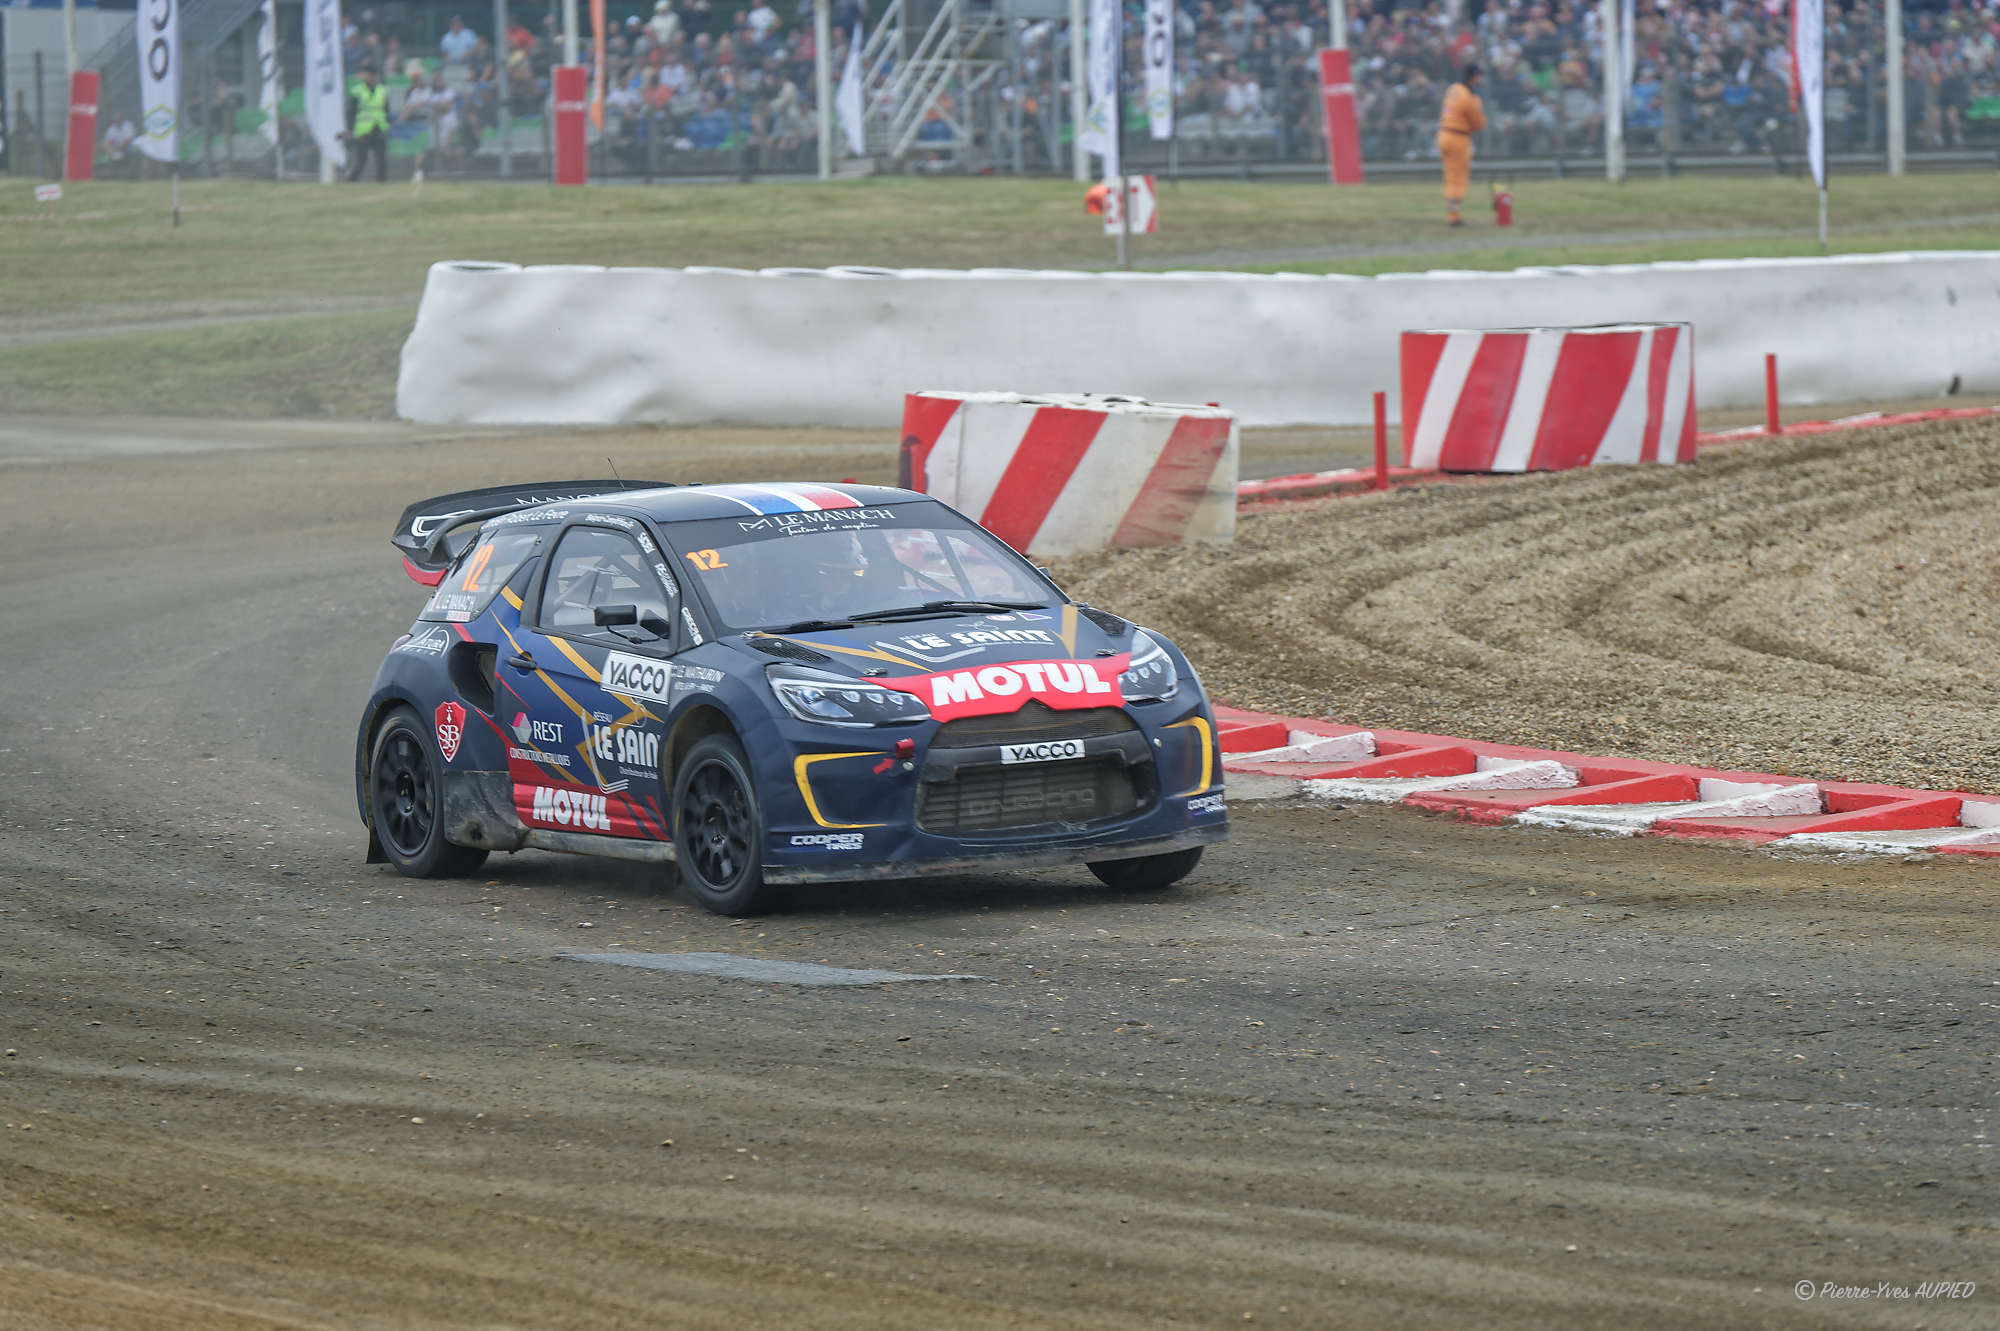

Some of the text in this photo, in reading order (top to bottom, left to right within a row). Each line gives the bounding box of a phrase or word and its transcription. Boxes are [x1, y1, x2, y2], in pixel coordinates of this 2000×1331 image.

[774, 514, 804, 527] LE
[462, 544, 495, 592] 12
[685, 548, 729, 571] 12
[905, 636, 952, 651] LE
[951, 629, 1053, 645] SAINT
[609, 660, 666, 695] YACCO
[930, 662, 1113, 707] MOTUL
[533, 720, 564, 744] REST
[594, 724, 662, 769] LE SAIN
[1009, 742, 1078, 762] YACCO
[532, 785, 611, 831] MOTUL
[1187, 793, 1224, 811] COOPER
[790, 832, 864, 846] COOPER
